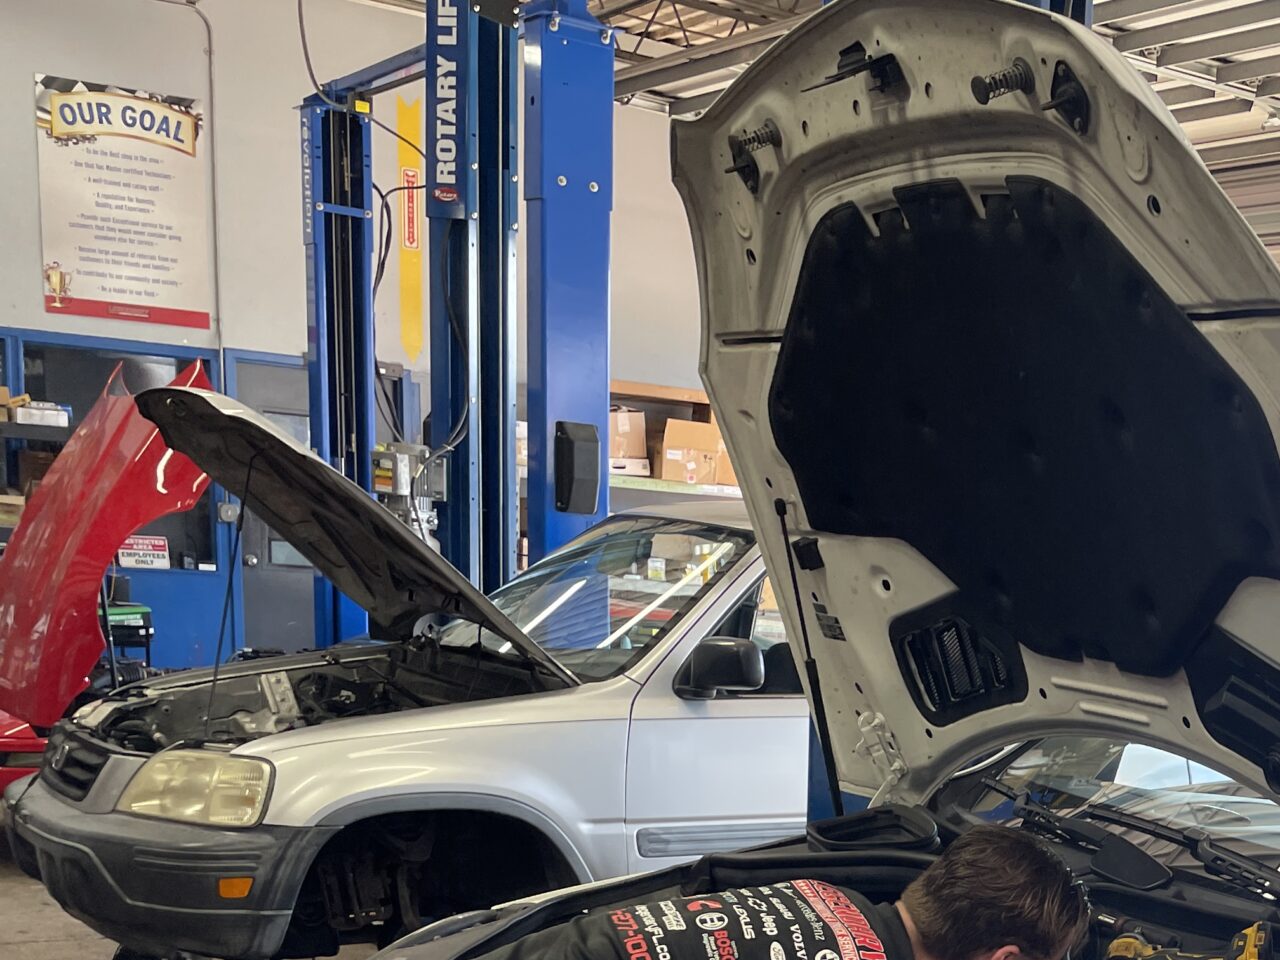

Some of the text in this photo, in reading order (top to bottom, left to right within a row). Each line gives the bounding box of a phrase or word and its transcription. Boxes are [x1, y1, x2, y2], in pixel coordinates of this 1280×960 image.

[59, 102, 185, 144] OUR GOAL
[436, 55, 457, 184] ROTARY
[121, 551, 166, 559] EMPLOYEES
[733, 904, 756, 939] LEXUS
[760, 913, 778, 935] Jeep
